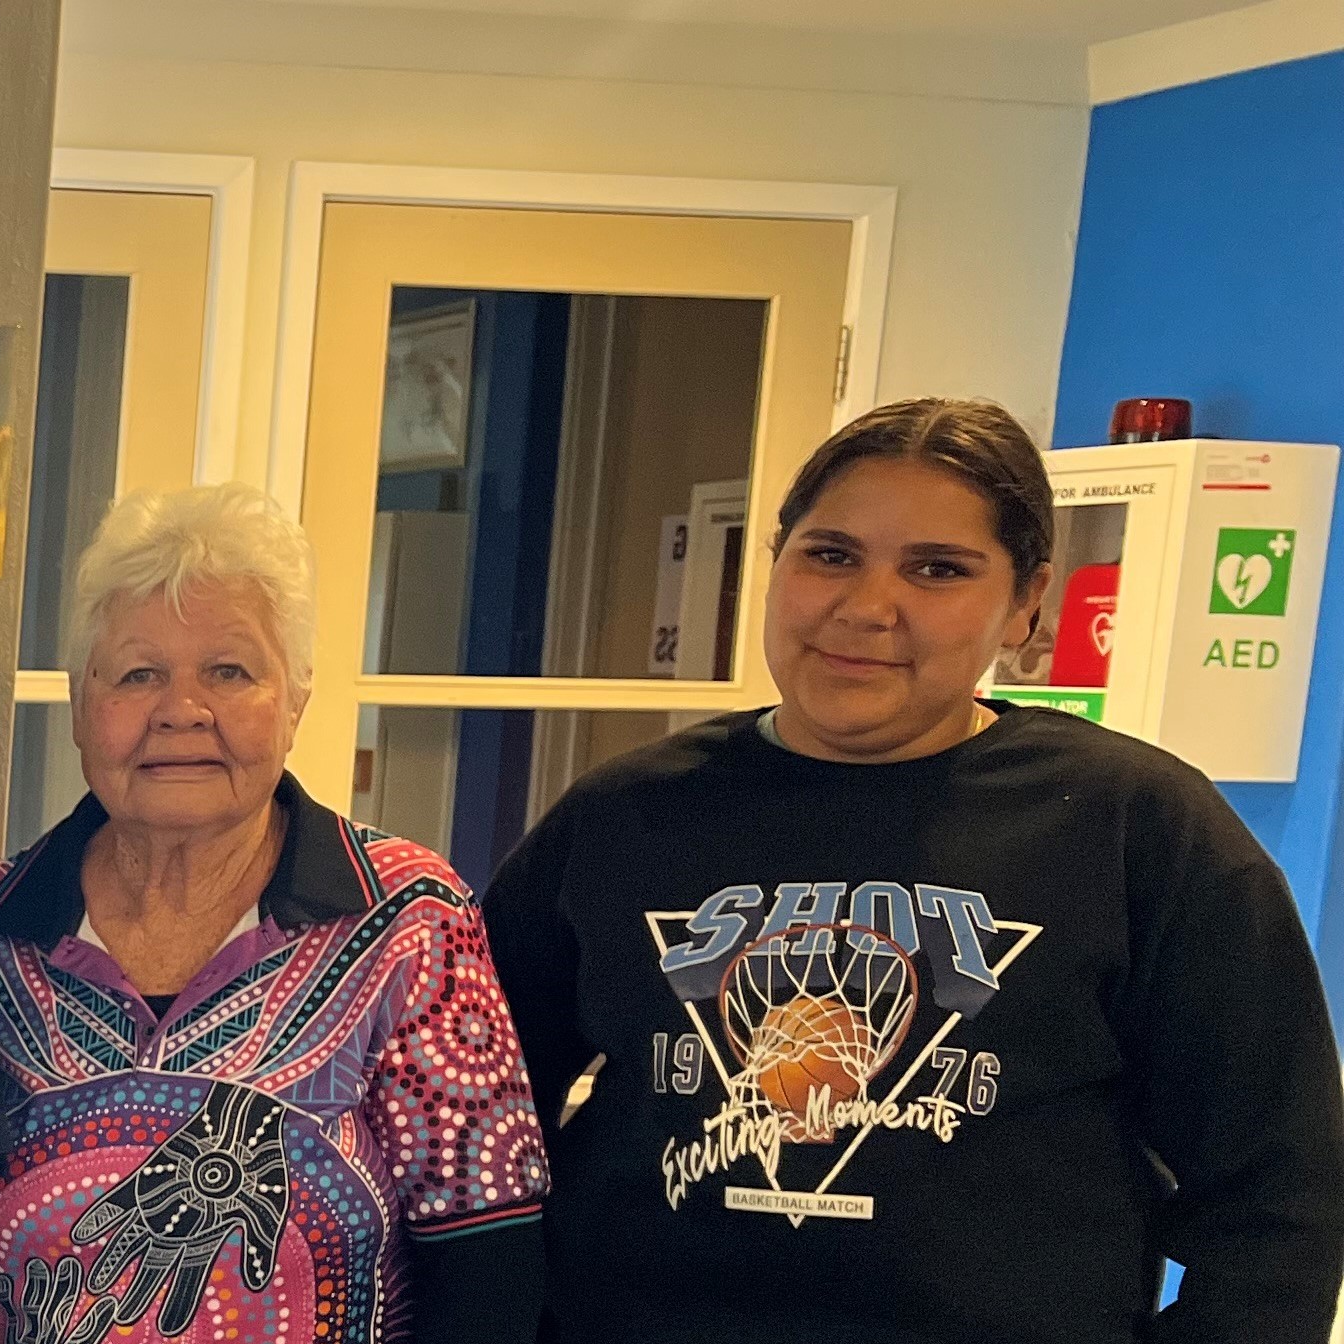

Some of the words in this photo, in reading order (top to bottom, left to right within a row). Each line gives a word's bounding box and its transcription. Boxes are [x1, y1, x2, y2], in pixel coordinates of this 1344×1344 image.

[1083, 482, 1157, 497] AMBULANCE
[1203, 638, 1281, 670] AED
[659, 881, 1000, 991] SHOT
[652, 1031, 705, 1096] 19
[931, 1045, 1002, 1116] 76
[662, 1100, 782, 1211] Exciting
[805, 1083, 966, 1143] Moments
[732, 1192, 812, 1211] BASKETBALL
[817, 1200, 865, 1214] MATCH
